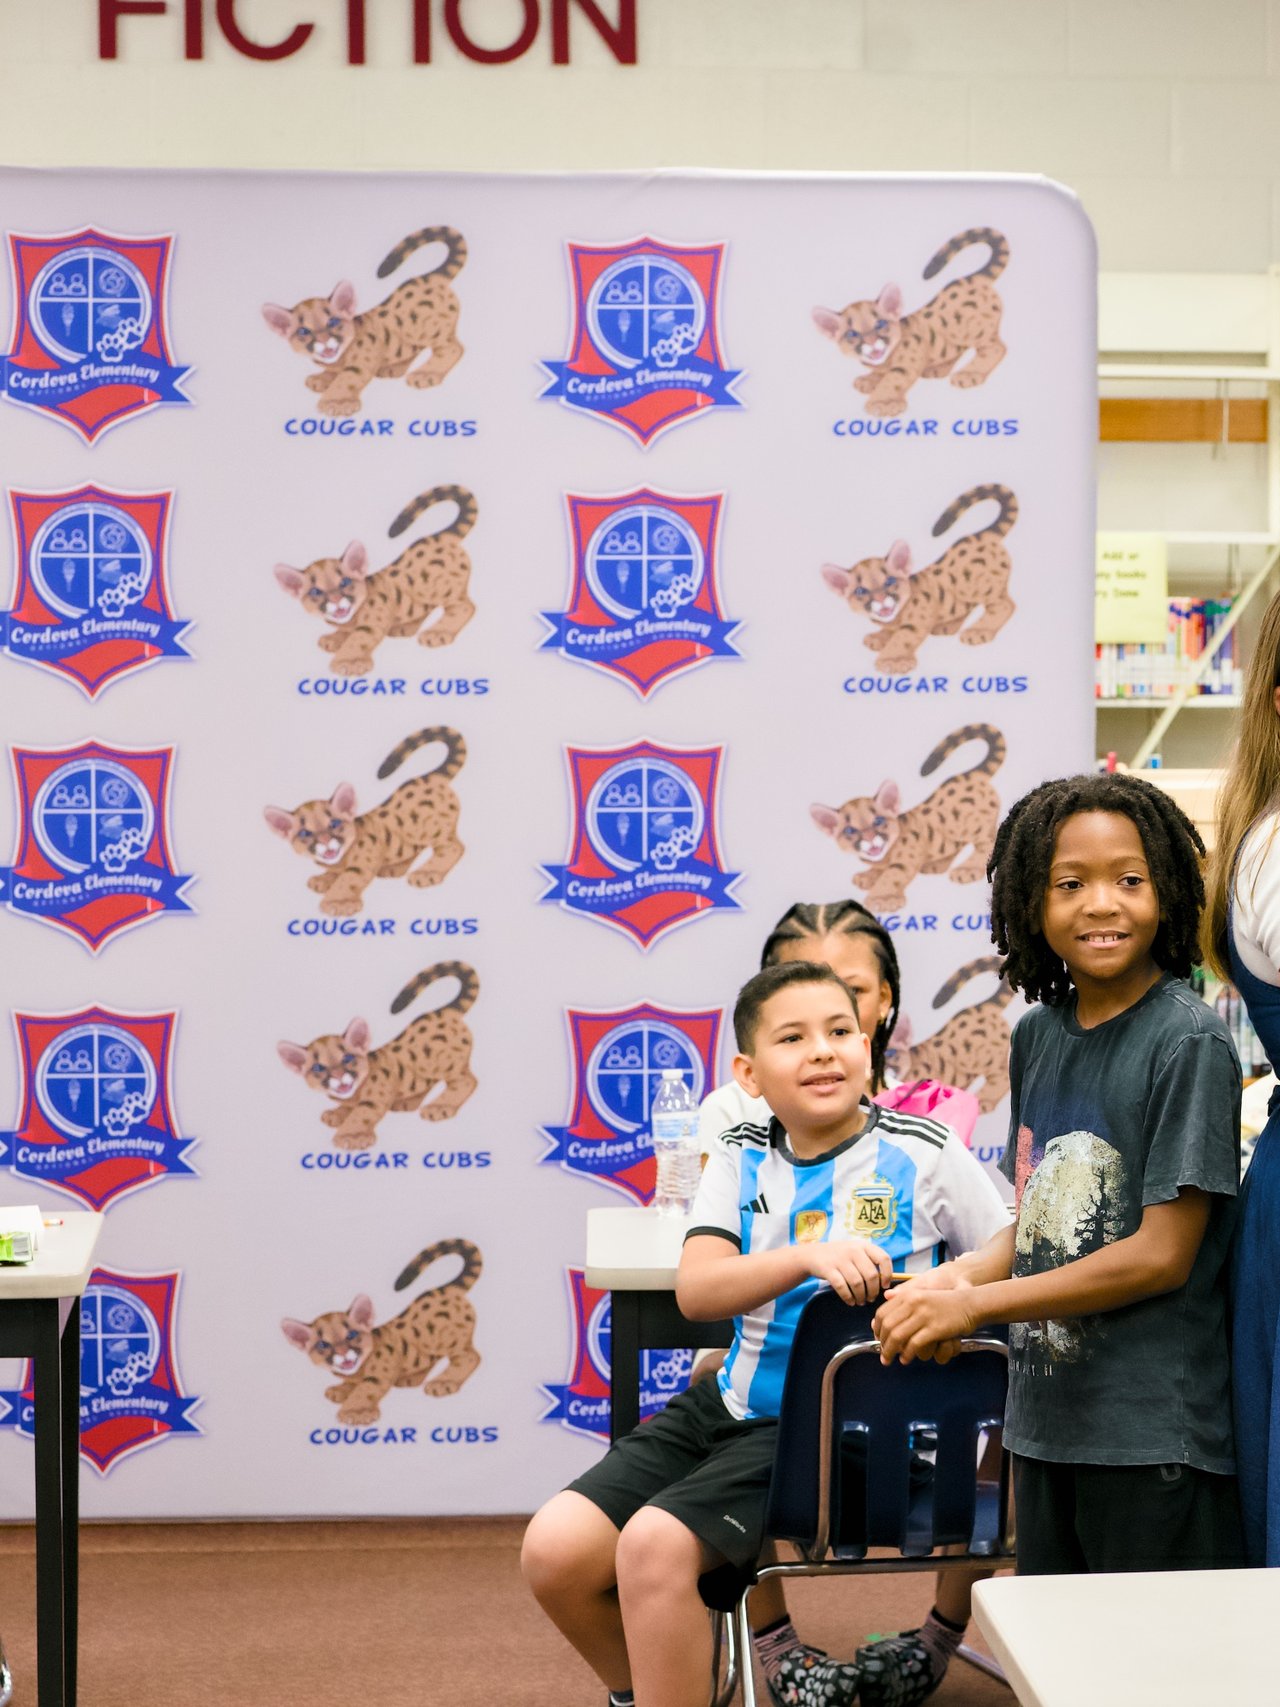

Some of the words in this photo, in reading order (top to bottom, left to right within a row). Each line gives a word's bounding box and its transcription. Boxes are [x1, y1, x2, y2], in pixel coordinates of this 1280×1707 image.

[9, 370, 78, 389] Cordova
[80, 363, 160, 383] Elementary
[636, 368, 713, 388] Elementary
[284, 418, 395, 437] COUGAR
[408, 419, 477, 438] CUBS
[832, 418, 939, 437] COUGAR
[951, 418, 1019, 438] CUBS
[82, 618, 160, 638] Elementary
[635, 619, 712, 639] Elementary
[297, 678, 407, 697] COUGAR
[420, 678, 489, 697] CUBS
[843, 676, 949, 695] COUGAR
[961, 675, 1028, 695] CUBS
[84, 873, 162, 893] Elementary
[635, 871, 712, 890] Elementary
[288, 918, 396, 937] COUGAR
[409, 918, 478, 937] CUBS
[878, 914, 938, 932] GAR
[87, 1136, 165, 1155] Elementary
[300, 1152, 409, 1170] COUGAR
[422, 1151, 492, 1170] CUBS
[857, 1197, 887, 1225] AFA
[92, 1396, 169, 1415] Elementary
[569, 1399, 611, 1417] Cord
[309, 1427, 416, 1446] COUGAR
[431, 1426, 497, 1445] CUBS
